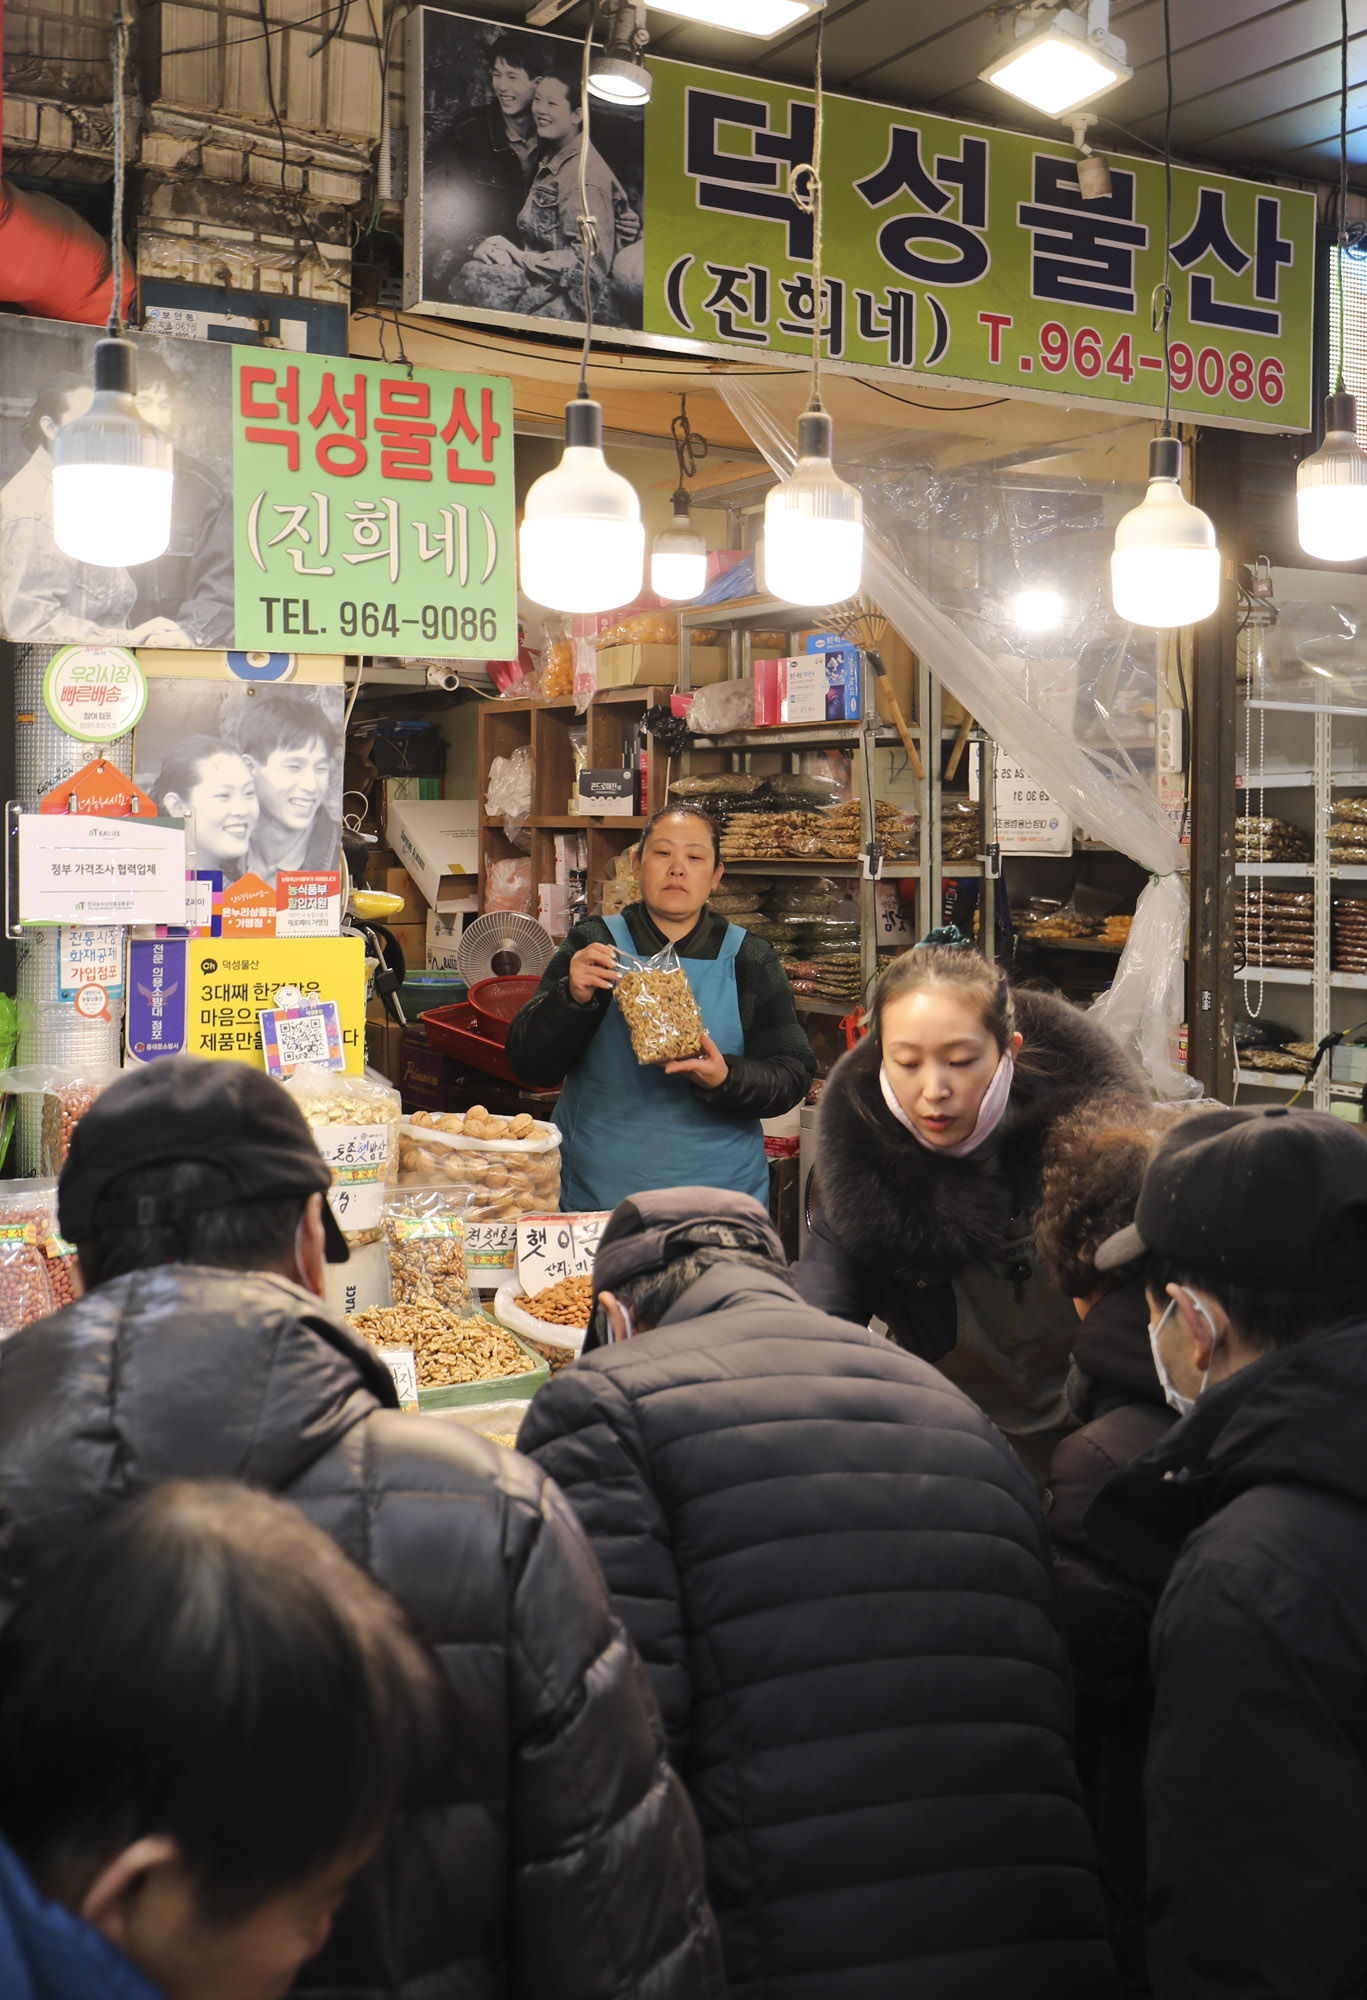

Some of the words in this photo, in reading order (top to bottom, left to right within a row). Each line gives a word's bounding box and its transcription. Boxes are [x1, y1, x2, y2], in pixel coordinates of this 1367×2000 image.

[685, 86, 1293, 337] 덕성물산
[665, 254, 950, 367] (진희네)
[239, 365, 501, 486] 덕성물산
[247, 490, 498, 588] (진희네)
[260, 597, 327, 635] TEL.
[340, 601, 497, 643] 964-9086
[70, 664, 132, 683] 우리시장
[60, 685, 122, 707] 빠른배송
[51, 863, 71, 875] 정부
[74, 863, 114, 875] 가격조사
[117, 863, 157, 875] 협력업체
[288, 884, 328, 896] 농식품부
[222, 907, 276, 918] 온누리상품권
[288, 897, 328, 910] 할인지원
[235, 918, 263, 928] 가맹점
[69, 930, 117, 946] 전통시장
[69, 947, 117, 963] 화재공제
[152, 944, 164, 964] 전문
[71, 965, 117, 982] 가입점포
[222, 960, 259, 971] 덕성물산
[152, 967, 163, 1017] 의용소방대
[201, 983, 248, 1002] 3대째
[151, 1020, 163, 1040] 점포
[352, 1168, 378, 1180] 한국산
[473, 1256, 504, 1264] 한국산
